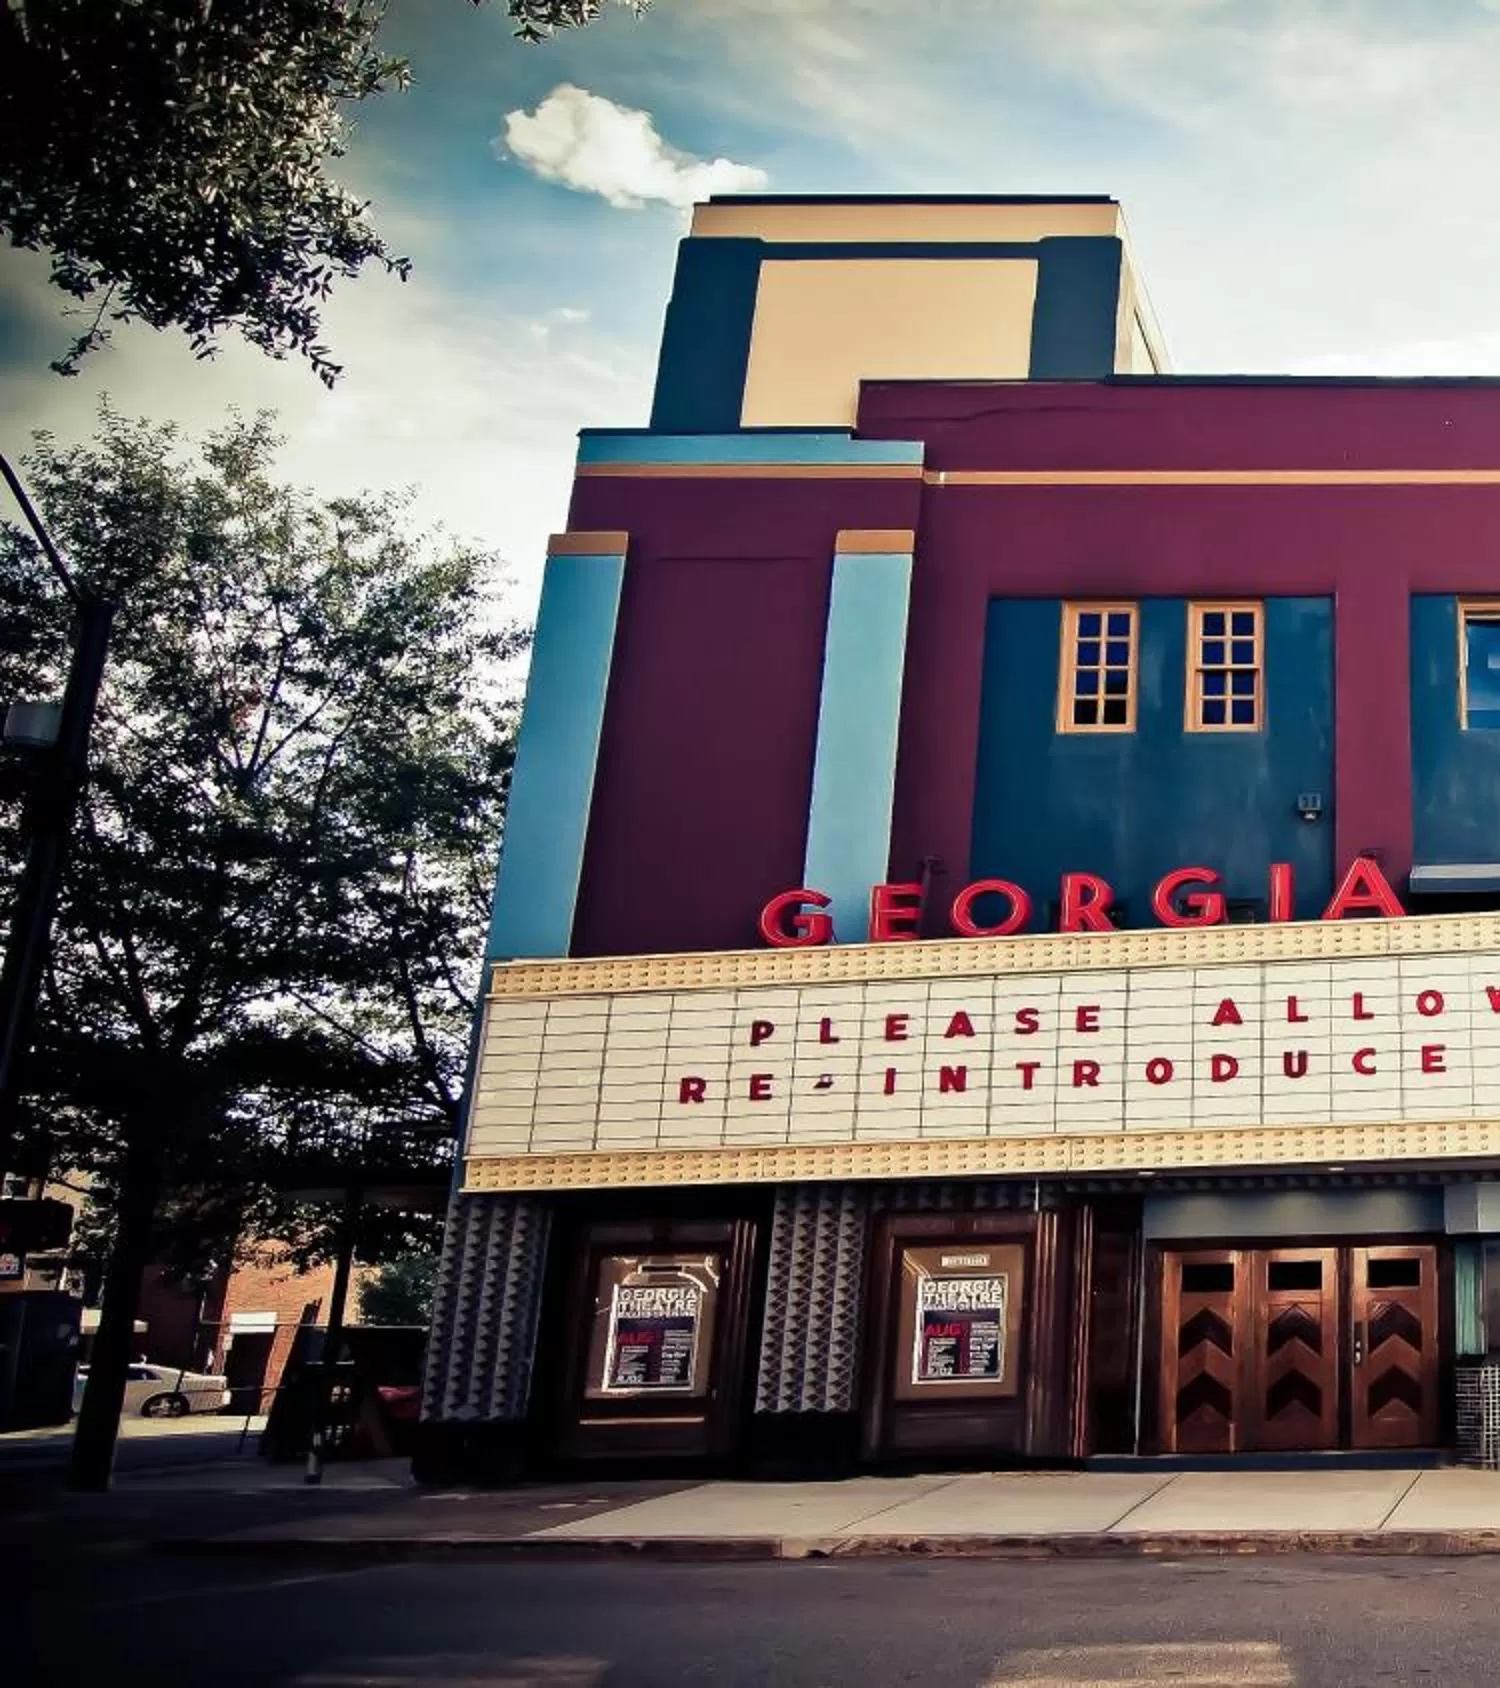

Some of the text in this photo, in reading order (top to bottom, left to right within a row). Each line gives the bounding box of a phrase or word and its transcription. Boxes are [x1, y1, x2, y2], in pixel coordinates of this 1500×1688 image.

[757, 857, 1407, 948] GEORGIA
[749, 1005, 1102, 1046] PLEASE
[923, 1280, 1001, 1293] GEORGIA
[620, 1287, 697, 1301] GEORGIA
[923, 1292, 1001, 1305] THEATRE
[618, 1300, 697, 1312] THEATRE
